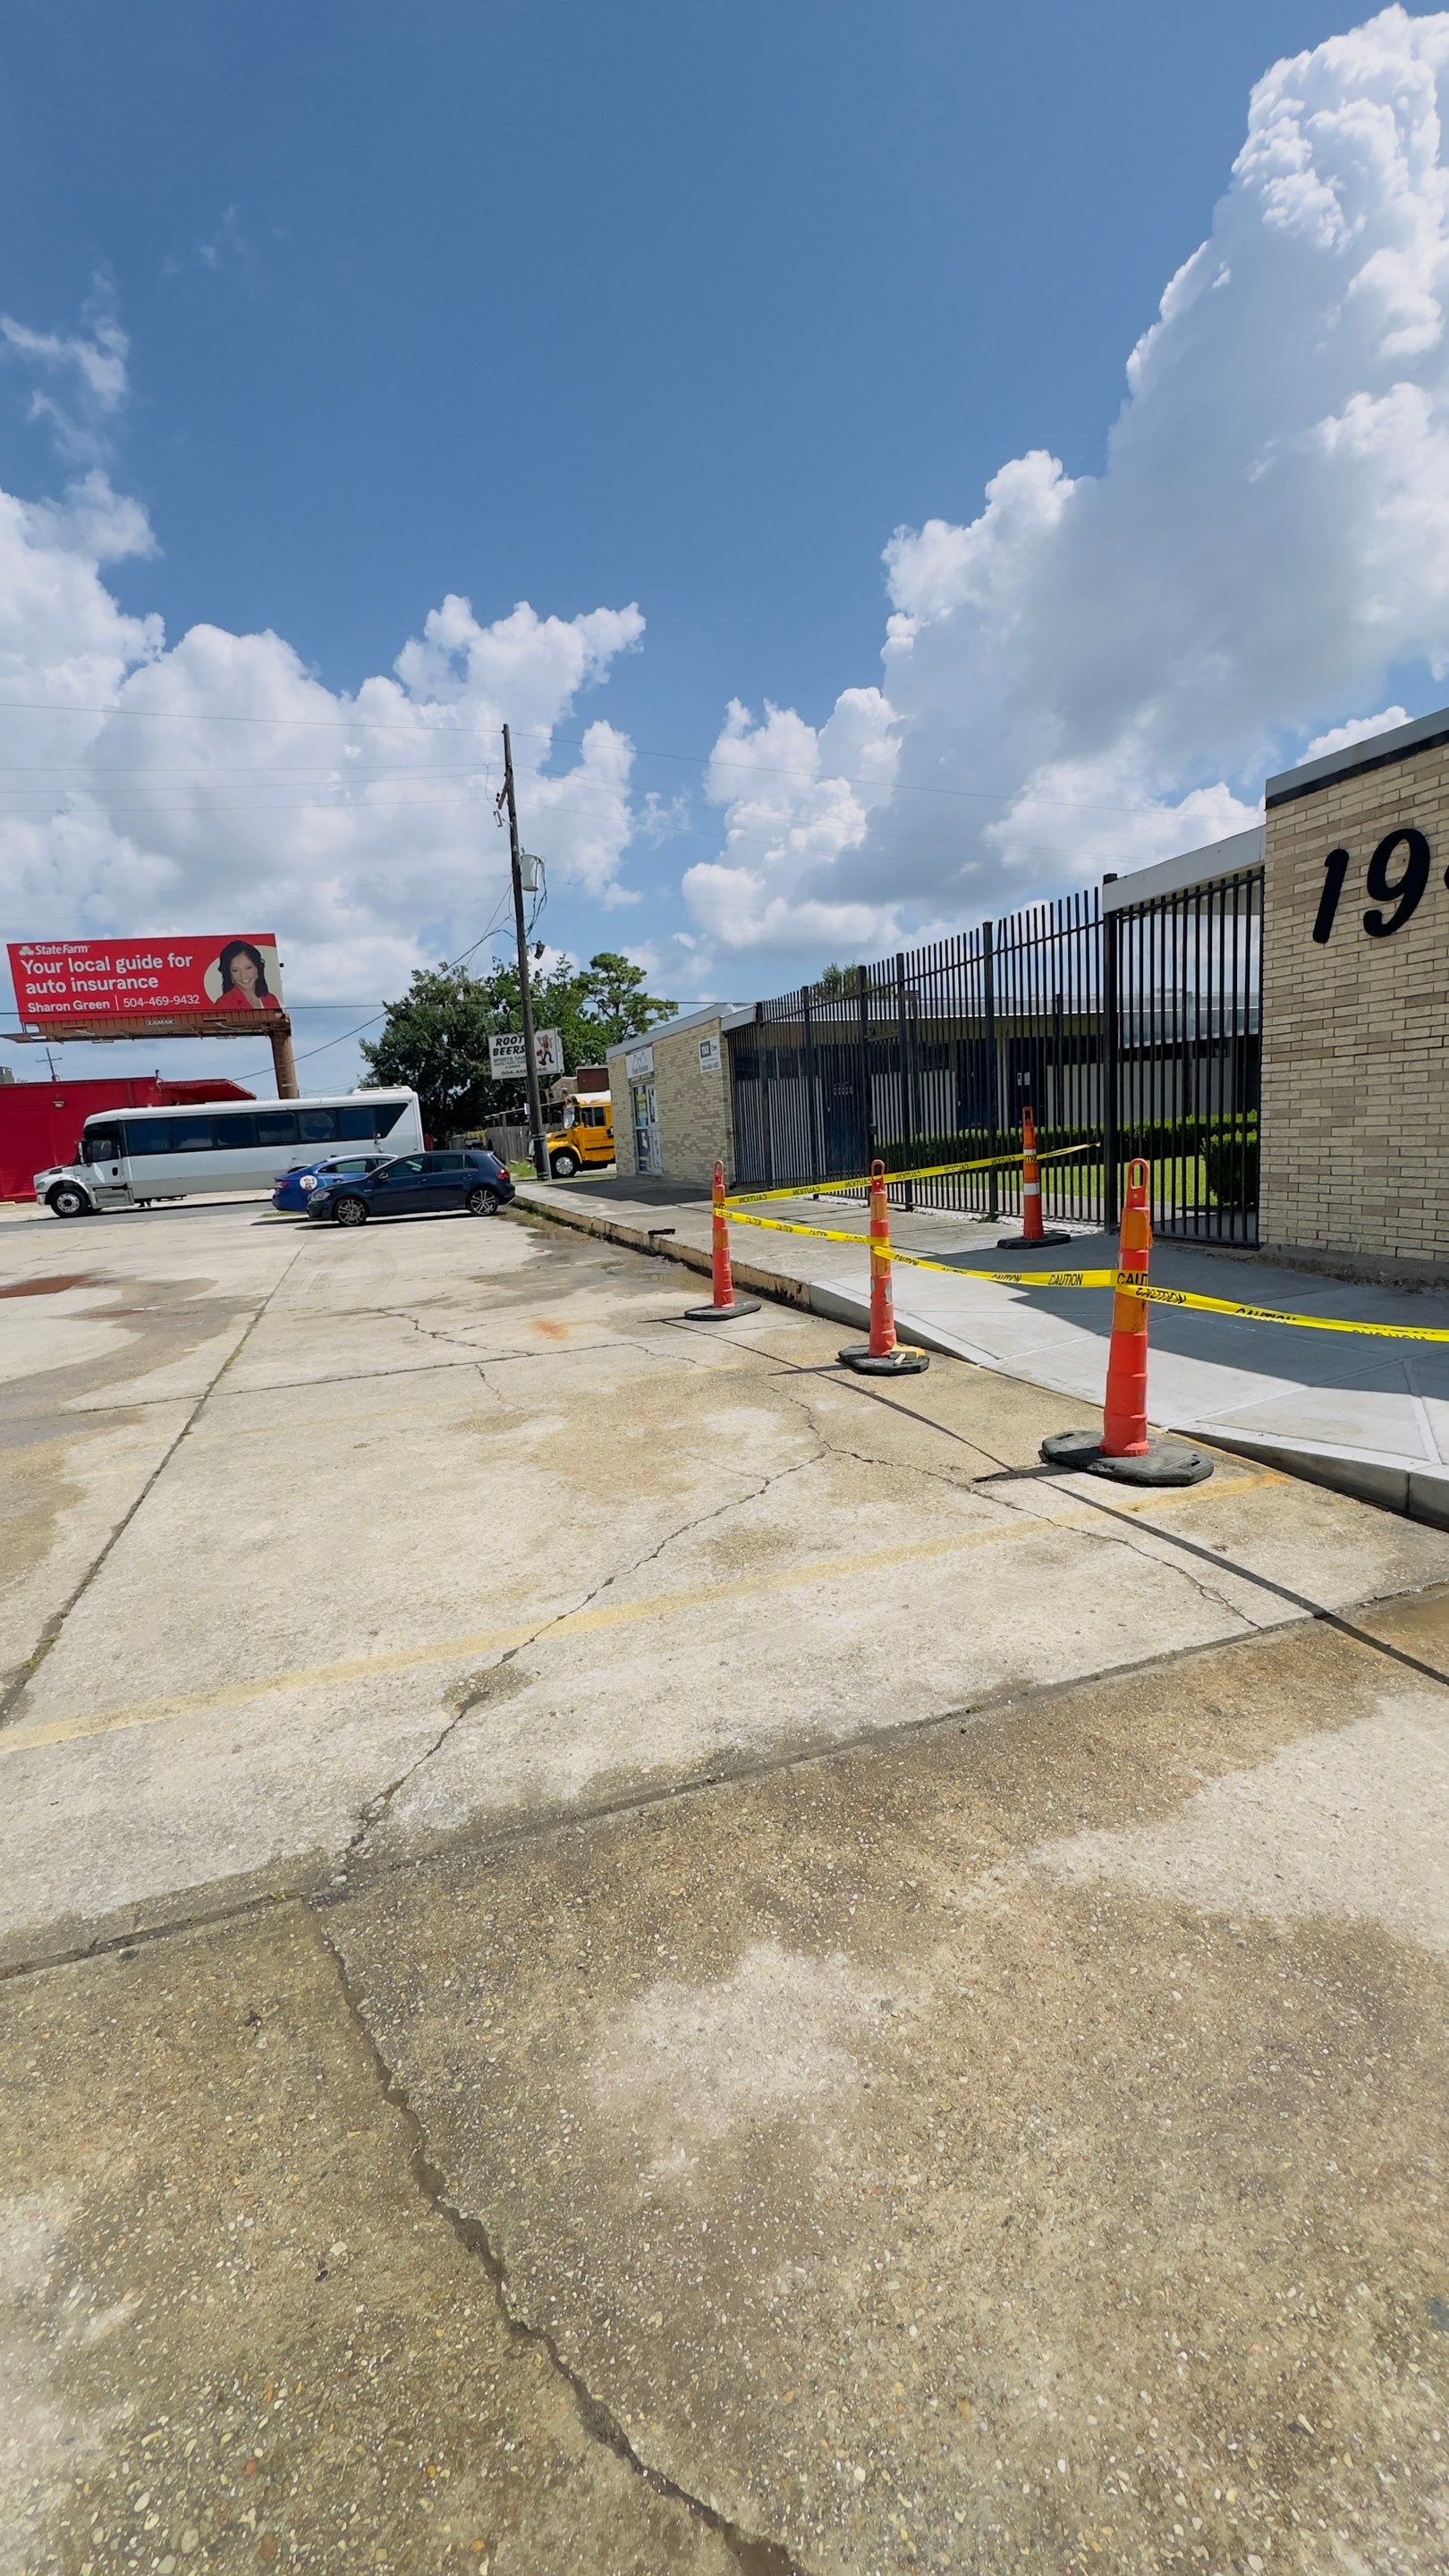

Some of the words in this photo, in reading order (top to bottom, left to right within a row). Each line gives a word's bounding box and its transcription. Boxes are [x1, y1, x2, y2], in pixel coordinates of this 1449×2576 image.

[1312, 828, 1449, 944] 19
[21, 959, 64, 975] Your
[68, 956, 110, 972] local
[115, 954, 163, 974] guide
[167, 953, 192, 968] for
[26, 979, 66, 995] auto
[71, 976, 159, 993] insurance
[28, 1000, 71, 1013] Sharon
[73, 998, 110, 1011] Green
[123, 994, 200, 1008] 504-469-9432
[496, 1036, 524, 1046] ROOT
[493, 1046, 525, 1056] BEERS
[1048, 1274, 1083, 1285] CAUTION
[1135, 1287, 1187, 1304] CAUTION
